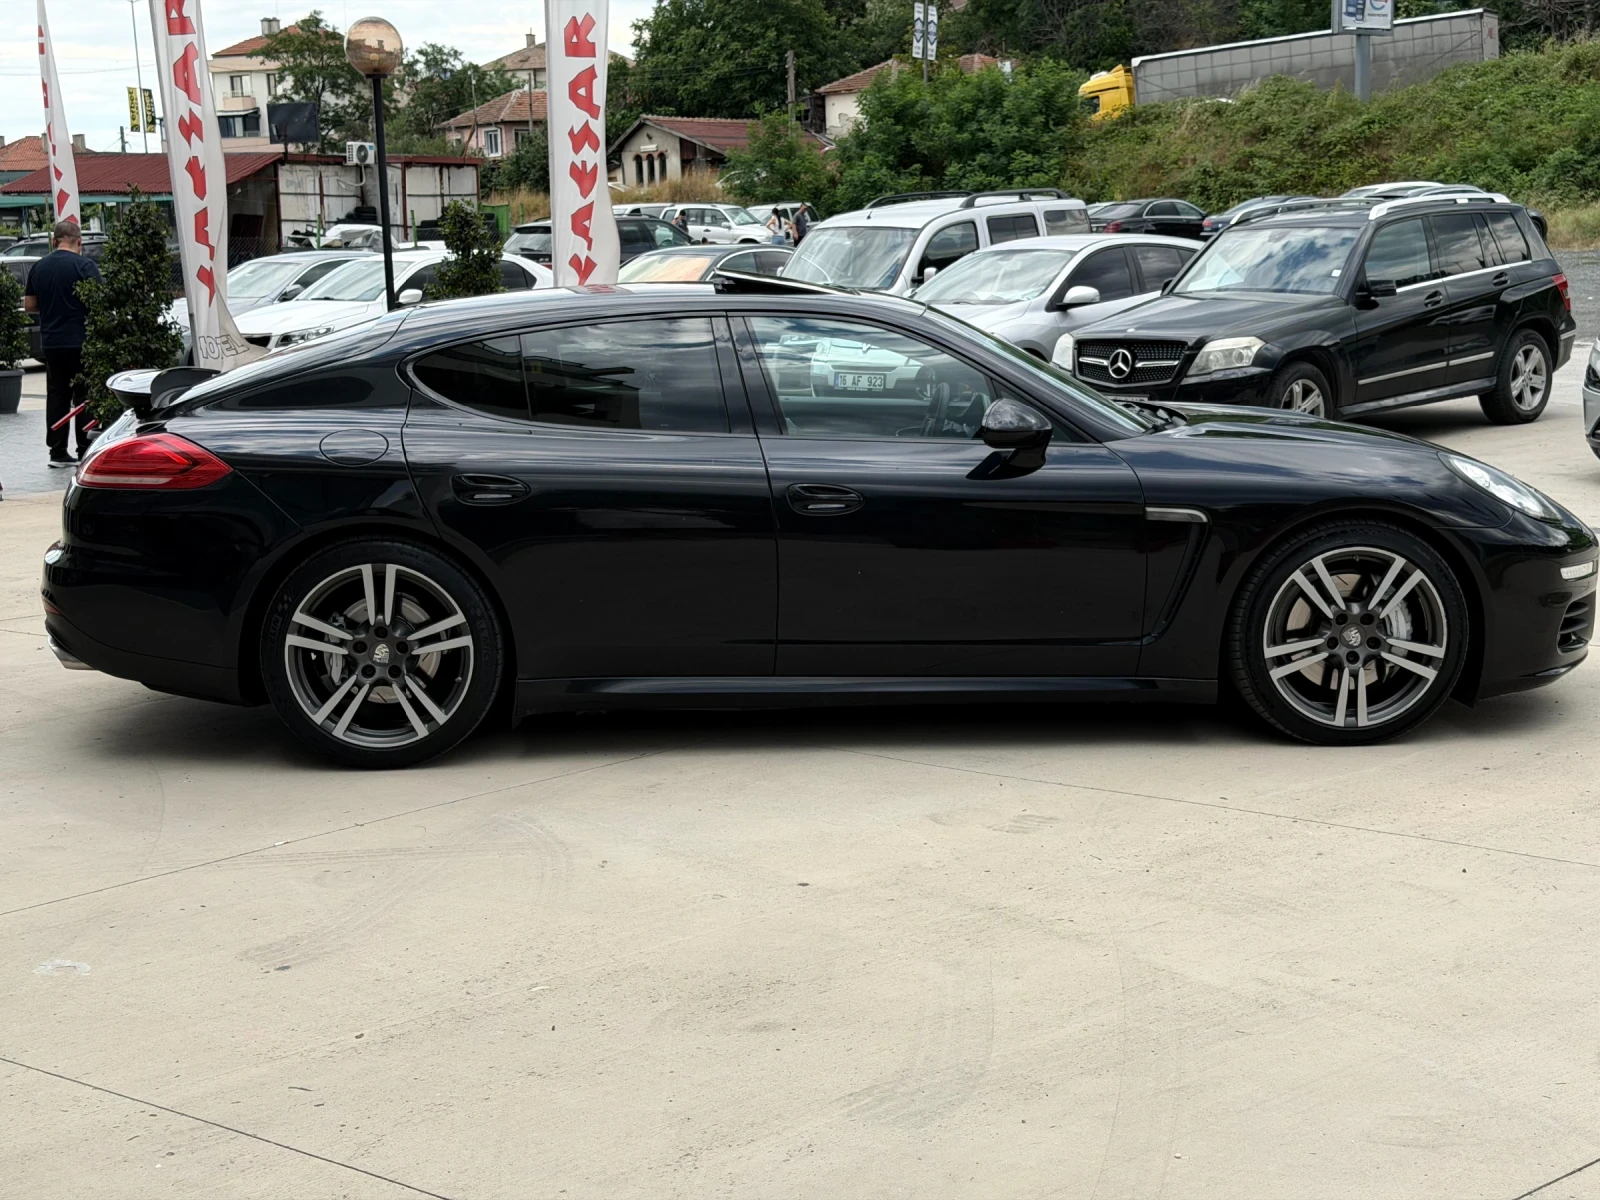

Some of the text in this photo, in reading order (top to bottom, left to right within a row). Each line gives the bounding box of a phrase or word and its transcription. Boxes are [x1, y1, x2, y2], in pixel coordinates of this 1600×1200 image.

[199, 334, 249, 360] OEL
[839, 375, 883, 387] 16 AF 923
